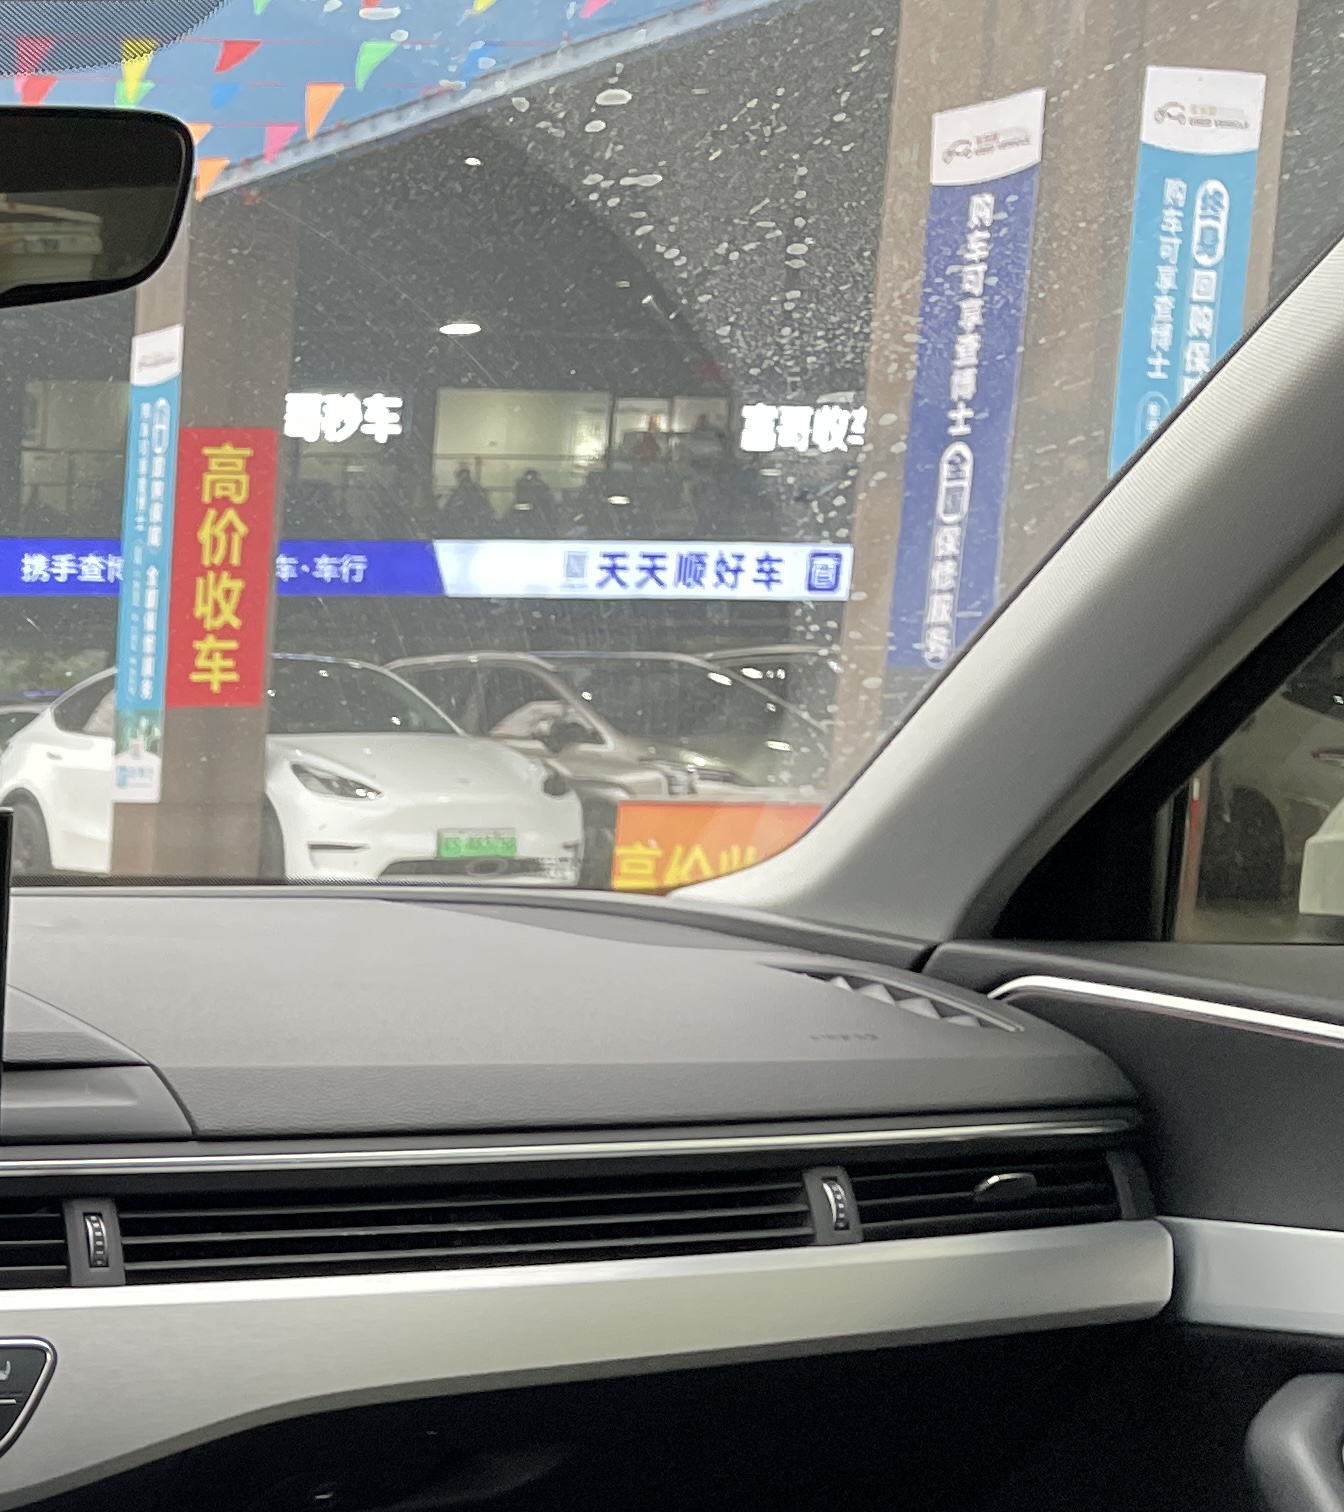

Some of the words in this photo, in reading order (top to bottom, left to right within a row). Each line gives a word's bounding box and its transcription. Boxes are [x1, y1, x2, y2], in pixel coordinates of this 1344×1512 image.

[188, 443, 254, 694] 高价收车
[596, 551, 783, 591] 天天顺好车
